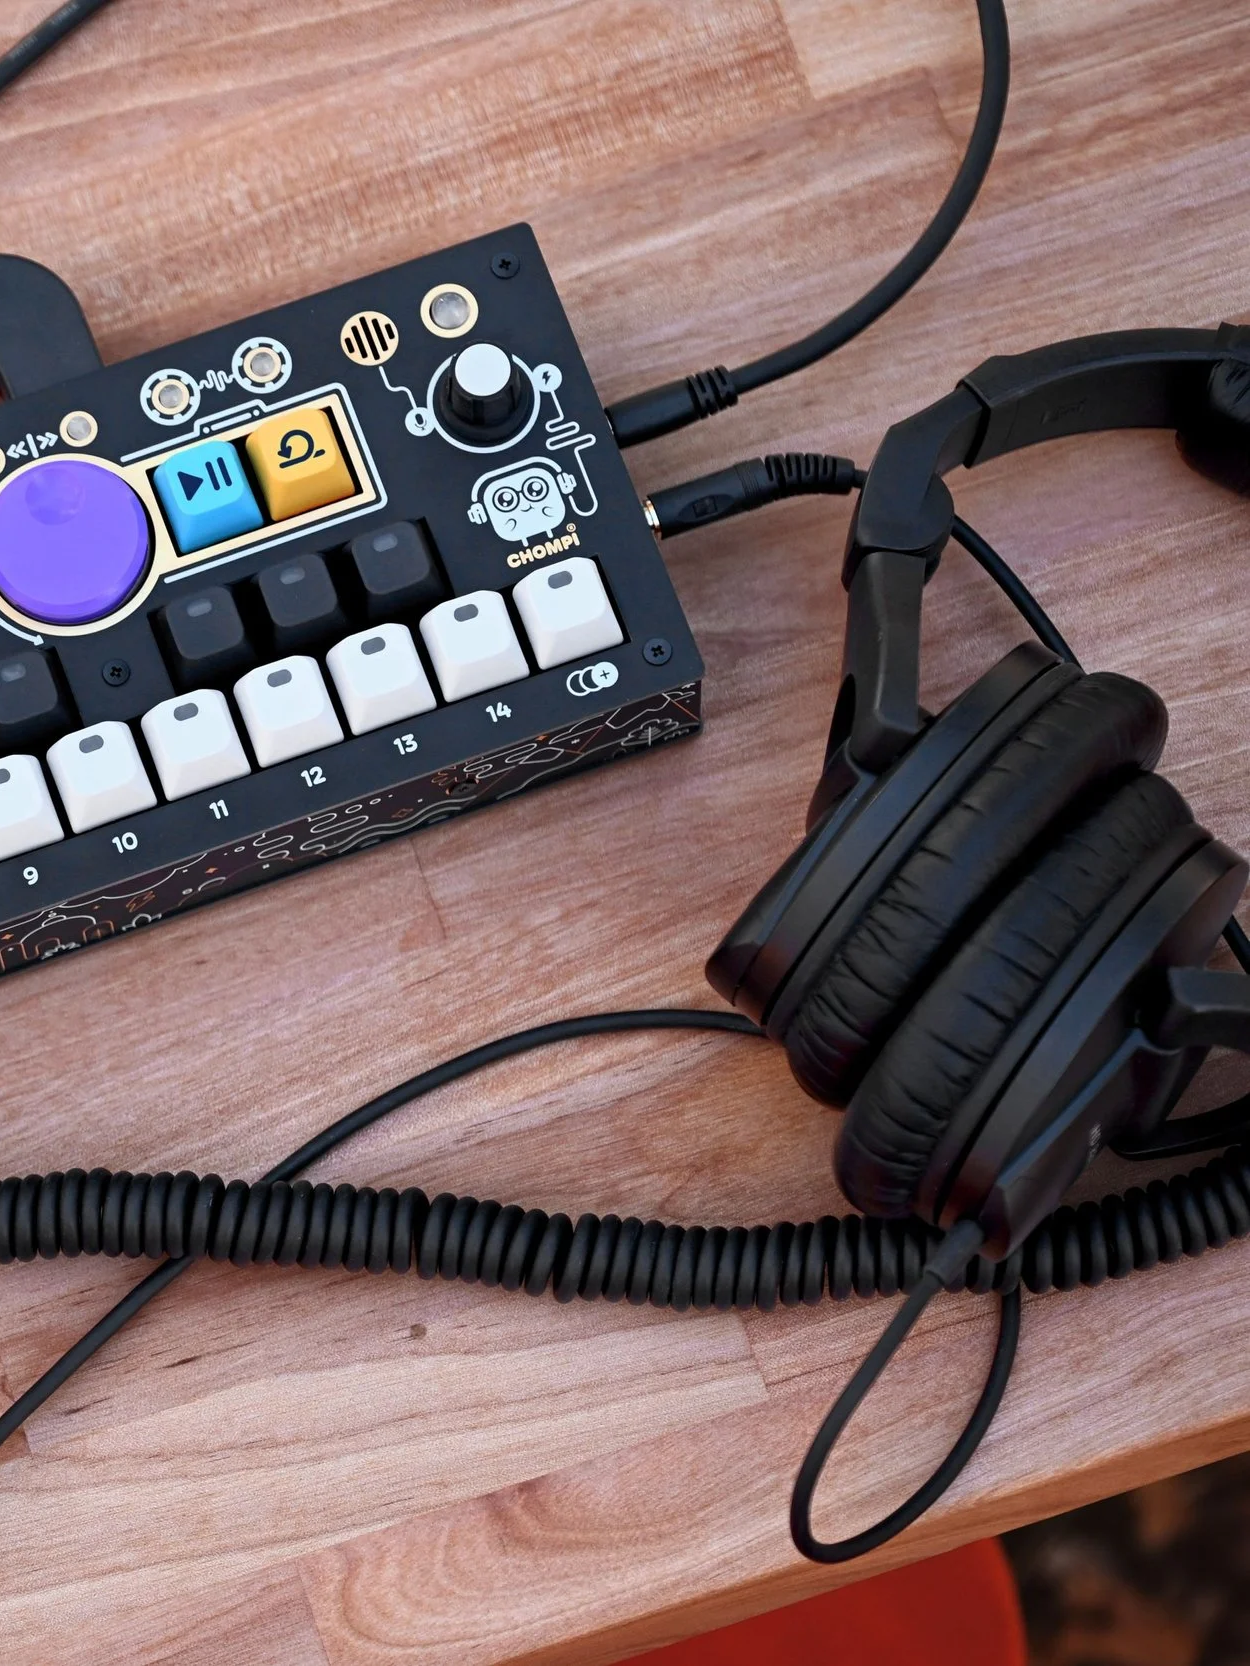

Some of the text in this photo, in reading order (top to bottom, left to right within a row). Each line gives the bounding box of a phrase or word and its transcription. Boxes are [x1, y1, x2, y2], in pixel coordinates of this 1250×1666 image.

[485, 701, 512, 723] 14
[393, 733, 419, 756] 13
[300, 765, 327, 788] 12
[208, 799, 229, 820] 11
[111, 831, 139, 854] 10
[22, 866, 39, 886] 9
